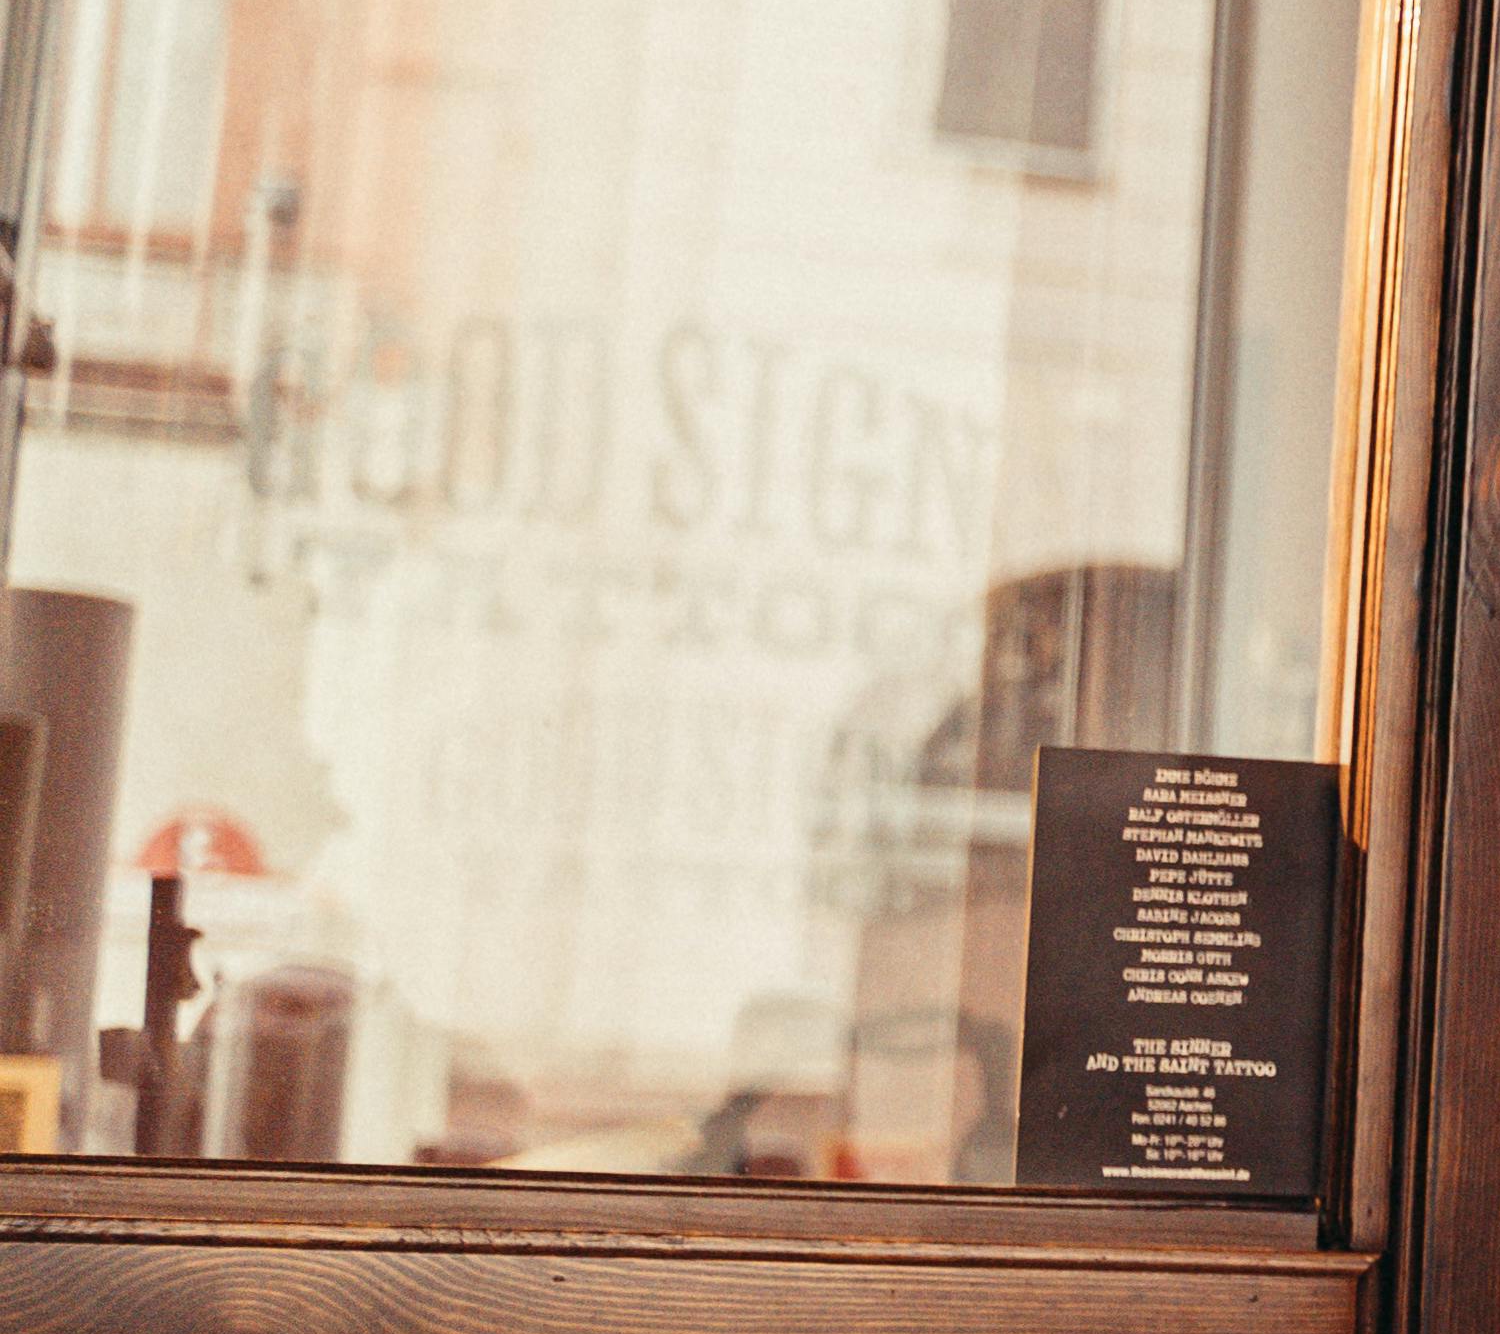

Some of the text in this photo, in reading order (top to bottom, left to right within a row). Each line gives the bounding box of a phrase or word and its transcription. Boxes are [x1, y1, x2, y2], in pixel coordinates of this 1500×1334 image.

[1143, 787, 1177, 803] SARA
[1128, 807, 1164, 823] RALF
[1122, 828, 1184, 843] STEPHAN
[1135, 848, 1179, 864] DAVID
[1149, 868, 1187, 884] PEPE
[1132, 887, 1184, 904] DENNIS
[1137, 908, 1241, 926] SABINE JACOBS
[1113, 927, 1190, 944] CHRISTOPH
[1141, 949, 1193, 964] MORRIS
[1122, 968, 1166, 983] CHRIS
[1127, 987, 1188, 1004] ANDREAS
[1133, 1038, 1232, 1058] THE SINNER
[1086, 1052, 1277, 1078] AND THE SAINT TATTOO
